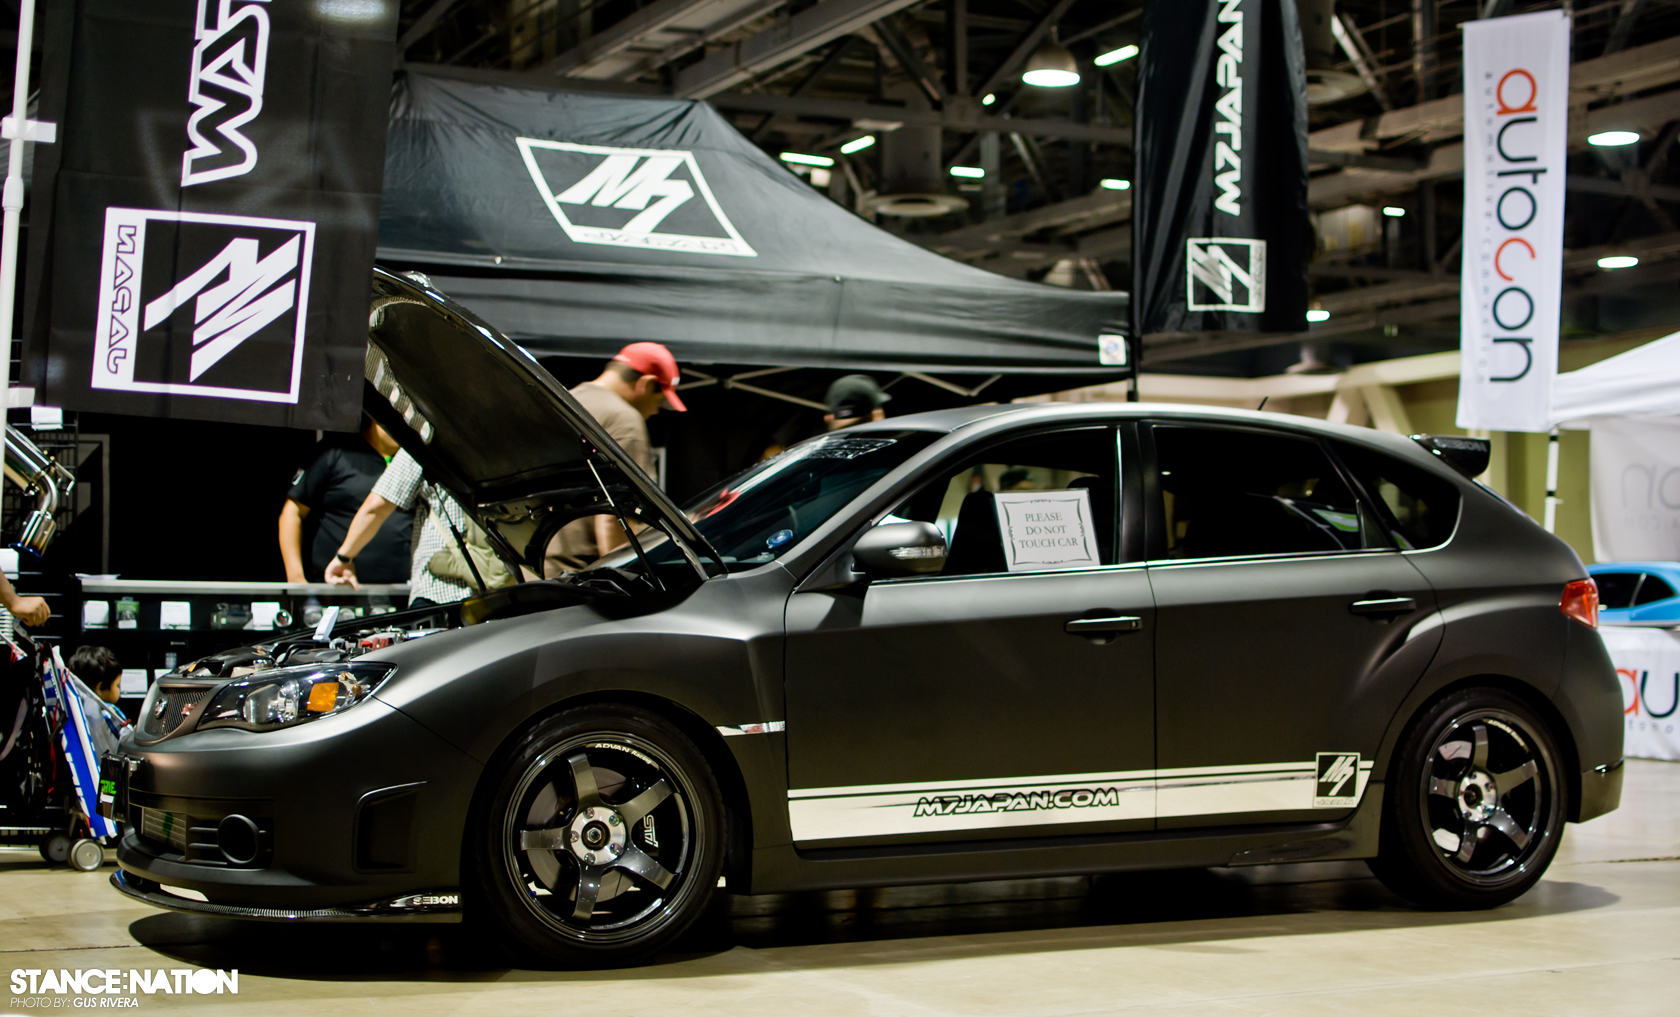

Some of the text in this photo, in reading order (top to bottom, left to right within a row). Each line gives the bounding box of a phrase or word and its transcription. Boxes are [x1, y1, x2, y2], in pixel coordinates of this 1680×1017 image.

[1489, 68, 1548, 382] autocon
[1025, 512, 1063, 522] PLEASE
[1026, 525, 1066, 535] DO NOT
[1019, 537, 1079, 549] TOUCH CAR
[595, 743, 630, 753] ADVAN
[913, 787, 1120, 818] M7JAPAN.COM
